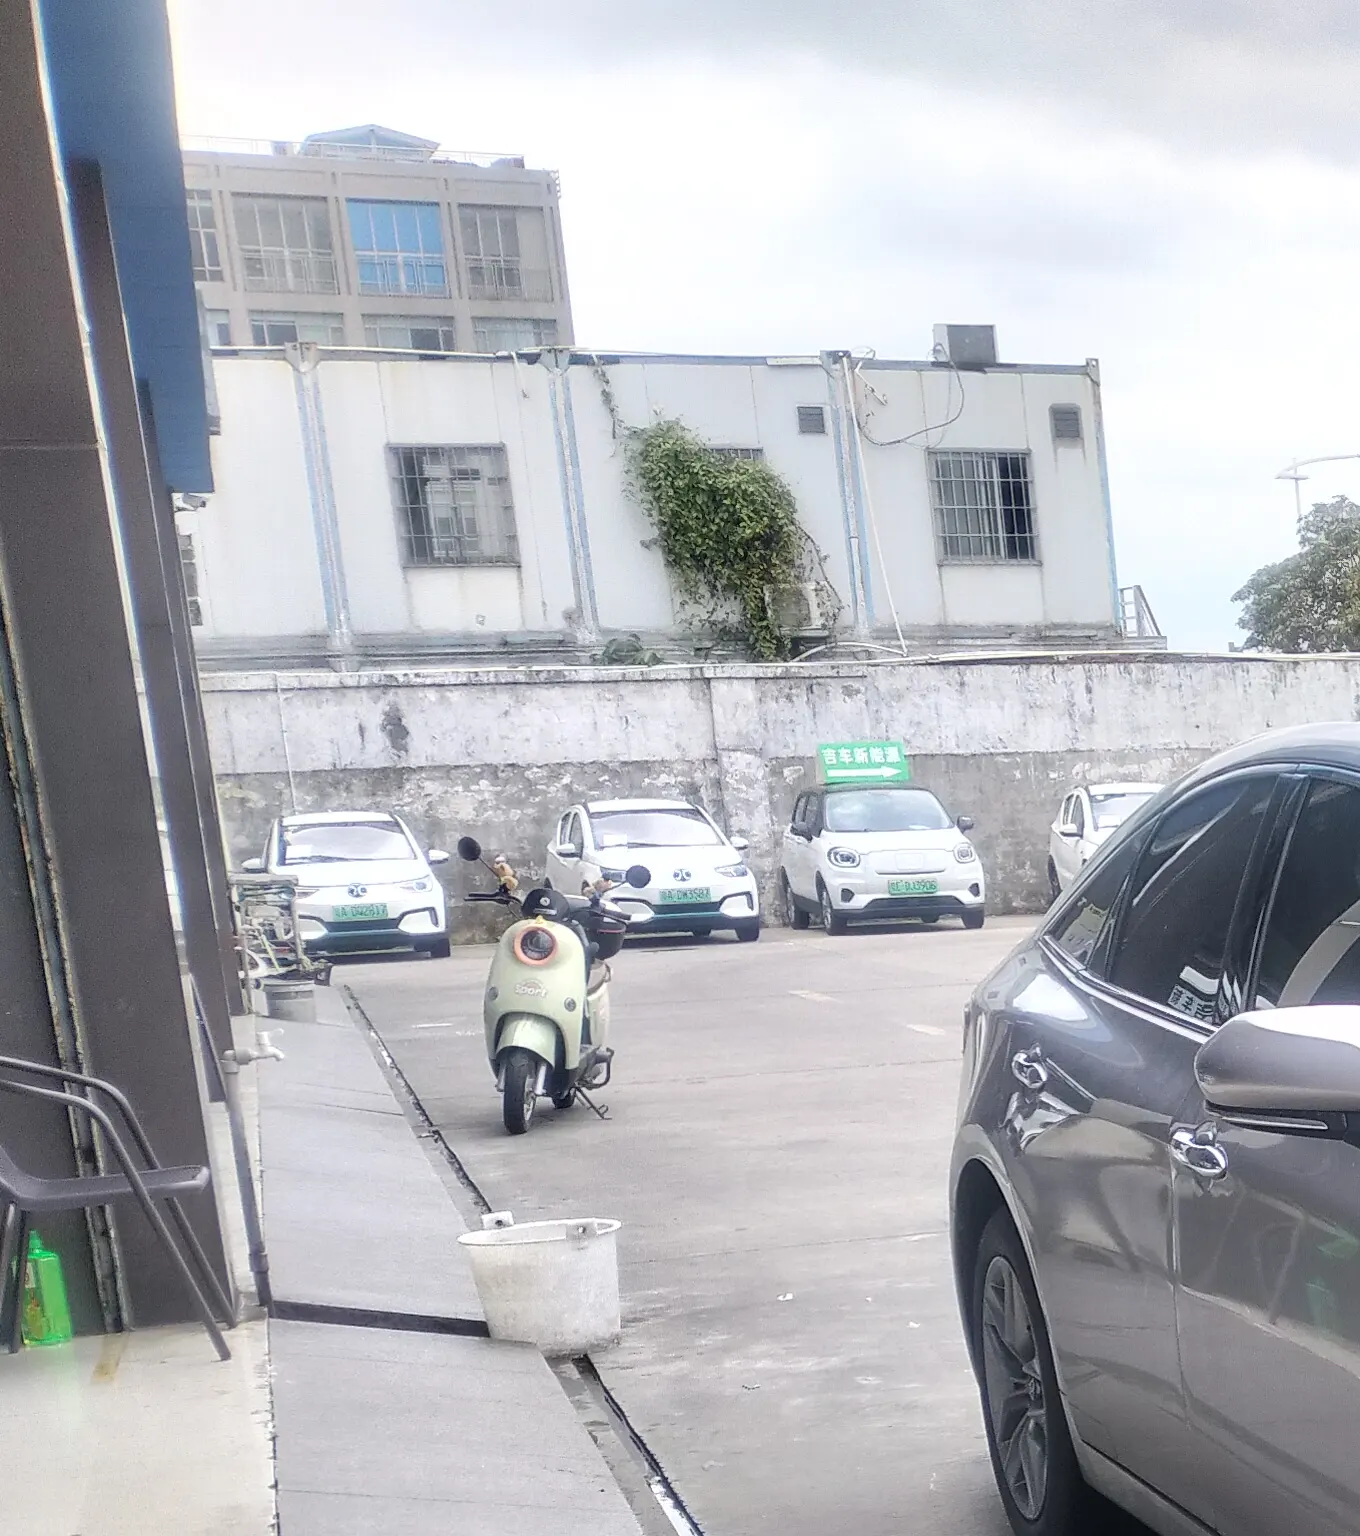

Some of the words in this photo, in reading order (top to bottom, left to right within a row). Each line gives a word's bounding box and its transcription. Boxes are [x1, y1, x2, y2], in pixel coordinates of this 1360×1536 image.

[823, 746, 901, 765] 吉车新能源
